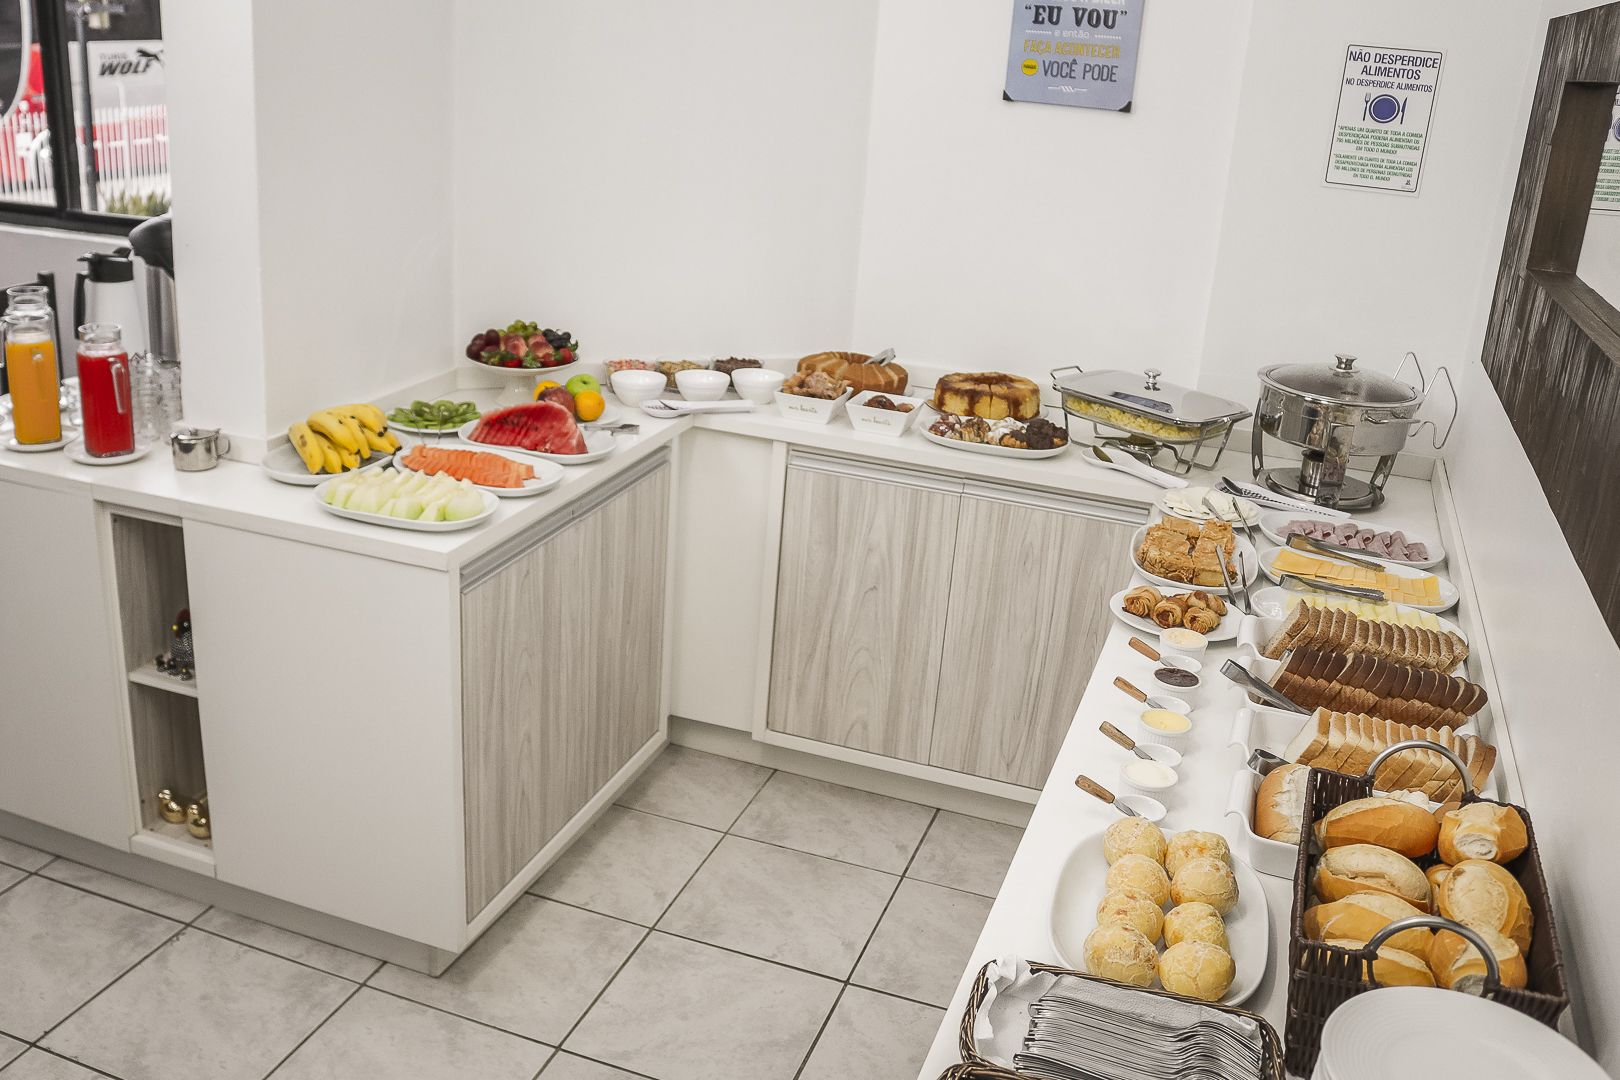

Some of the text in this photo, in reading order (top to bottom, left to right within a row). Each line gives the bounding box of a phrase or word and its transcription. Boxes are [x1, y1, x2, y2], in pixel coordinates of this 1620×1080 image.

[1062, 30, 1090, 39] então
[1023, 40, 1052, 55] FAÇA
[1349, 49, 1439, 68] NÃO DESPERDICE
[99, 60, 153, 76] WOLF
[1042, 58, 1119, 82] VOCÊ PODE
[1361, 65, 1421, 80] ALIMENTOS
[1357, 79, 1395, 89] DESPERDICE
[1396, 82, 1433, 92] ALIMENTOS
